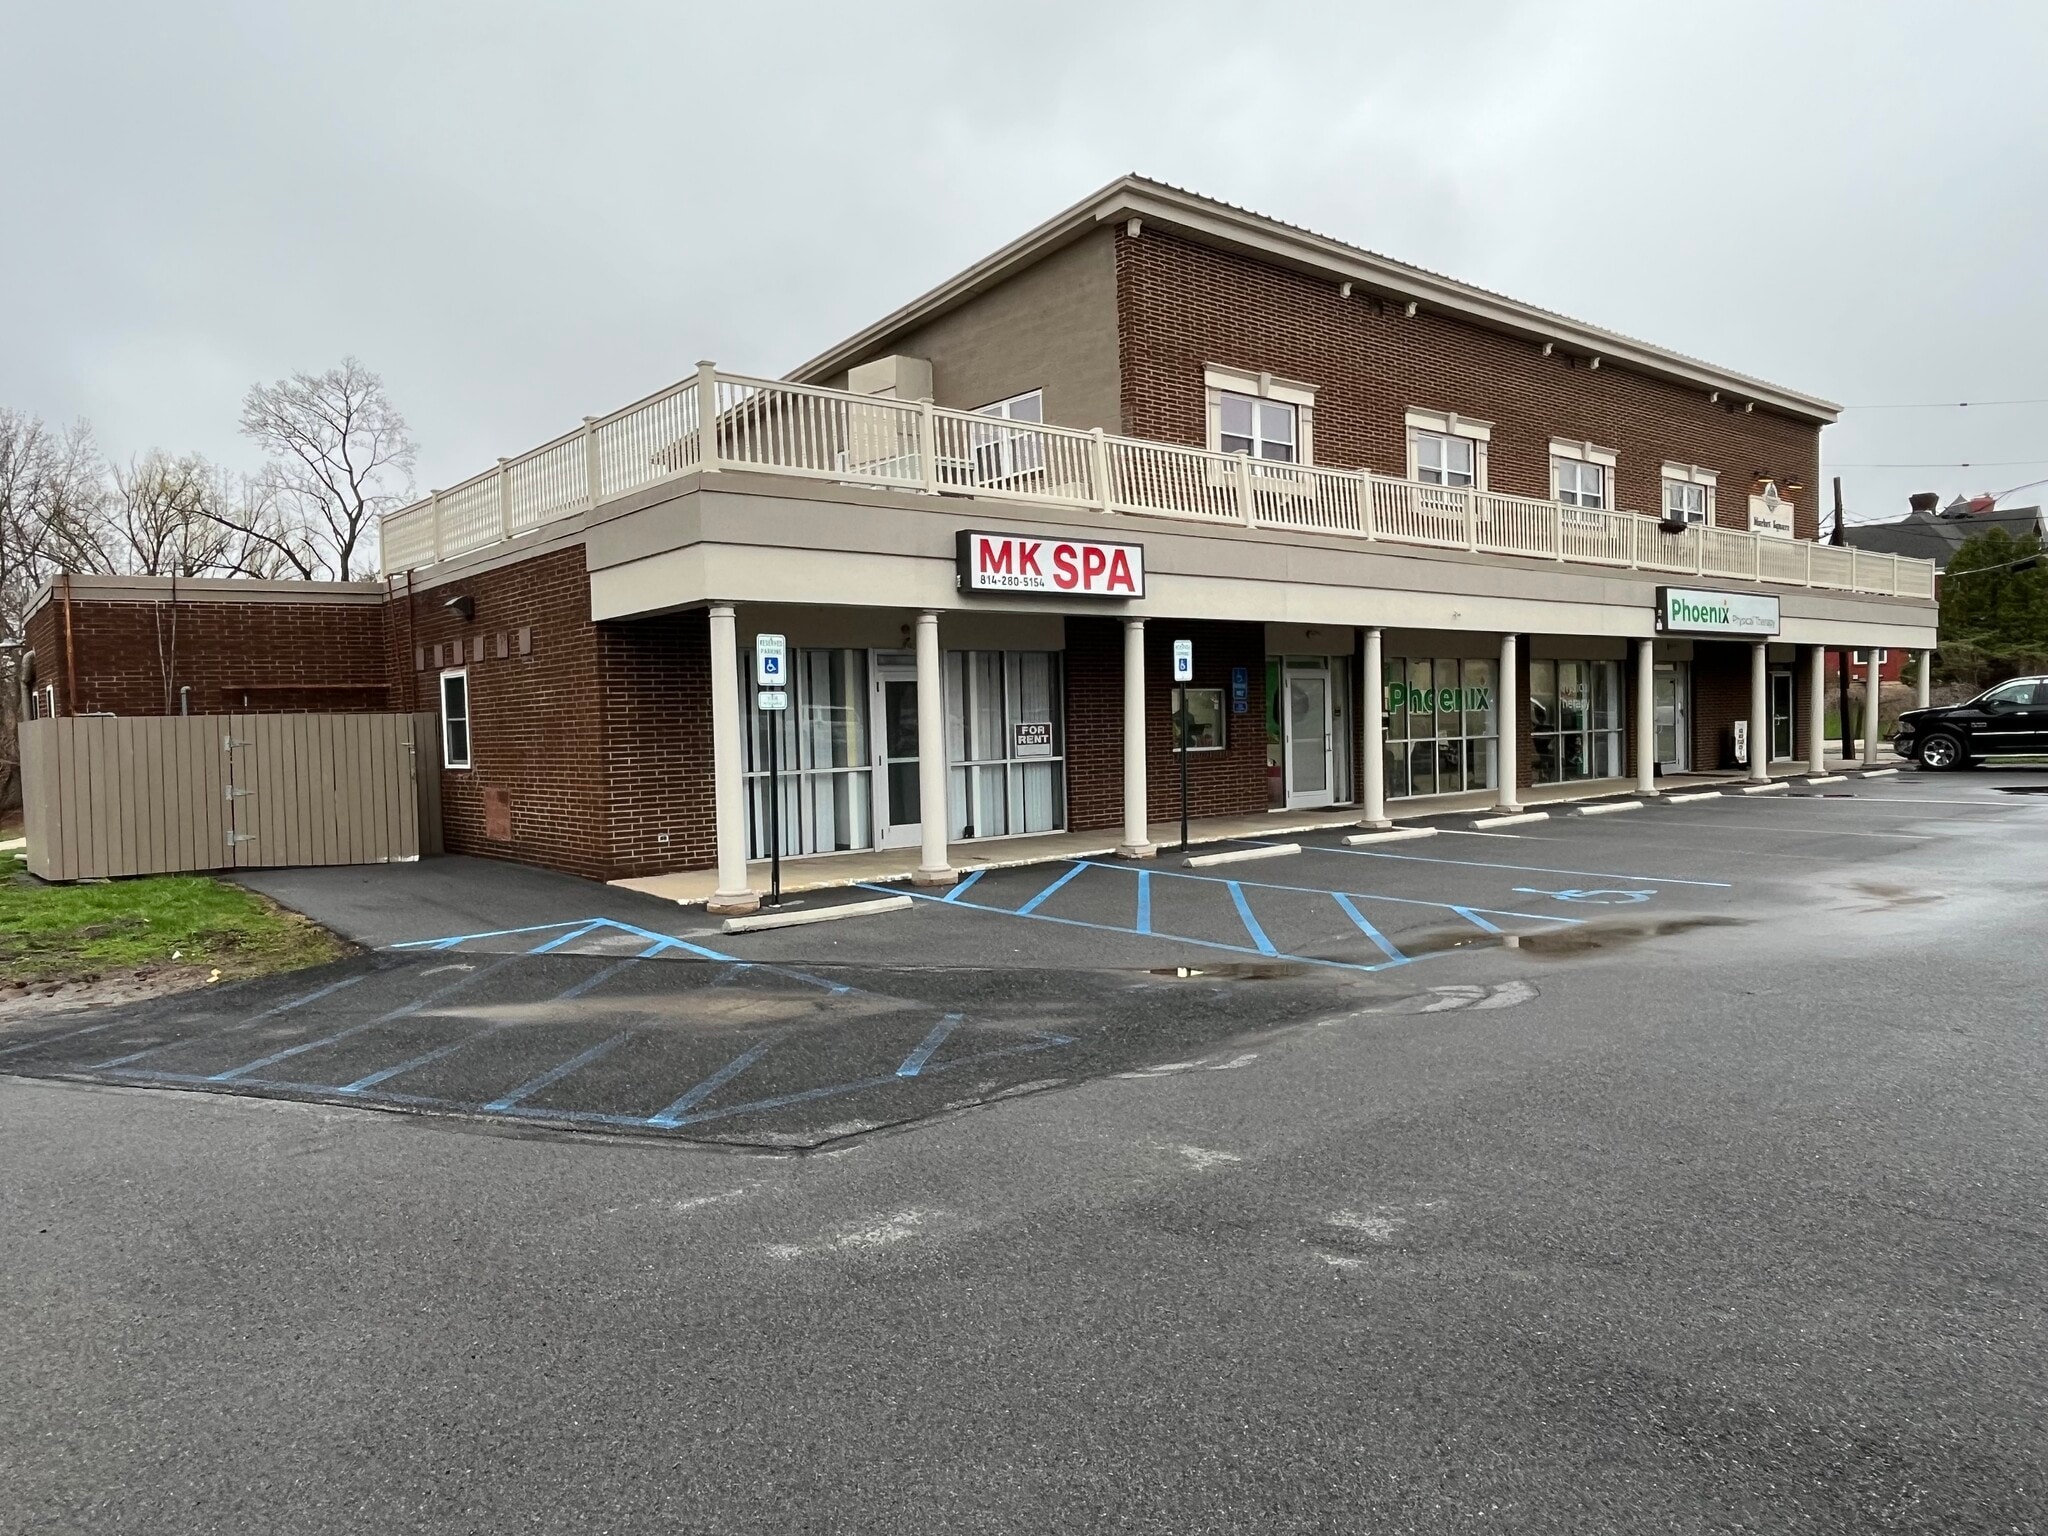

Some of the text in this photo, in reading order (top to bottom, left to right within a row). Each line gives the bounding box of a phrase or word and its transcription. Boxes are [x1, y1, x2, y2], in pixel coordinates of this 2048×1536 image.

[979, 538, 1136, 593] MK SPA
[980, 574, 1045, 588] 814-280-5154
[1671, 598, 1730, 624] Phoenix
[760, 648, 782, 656] PARKING
[1388, 679, 1491, 715] Phoenix
[1021, 725, 1045, 735] FOR
[1017, 734, 1049, 744] RENT
